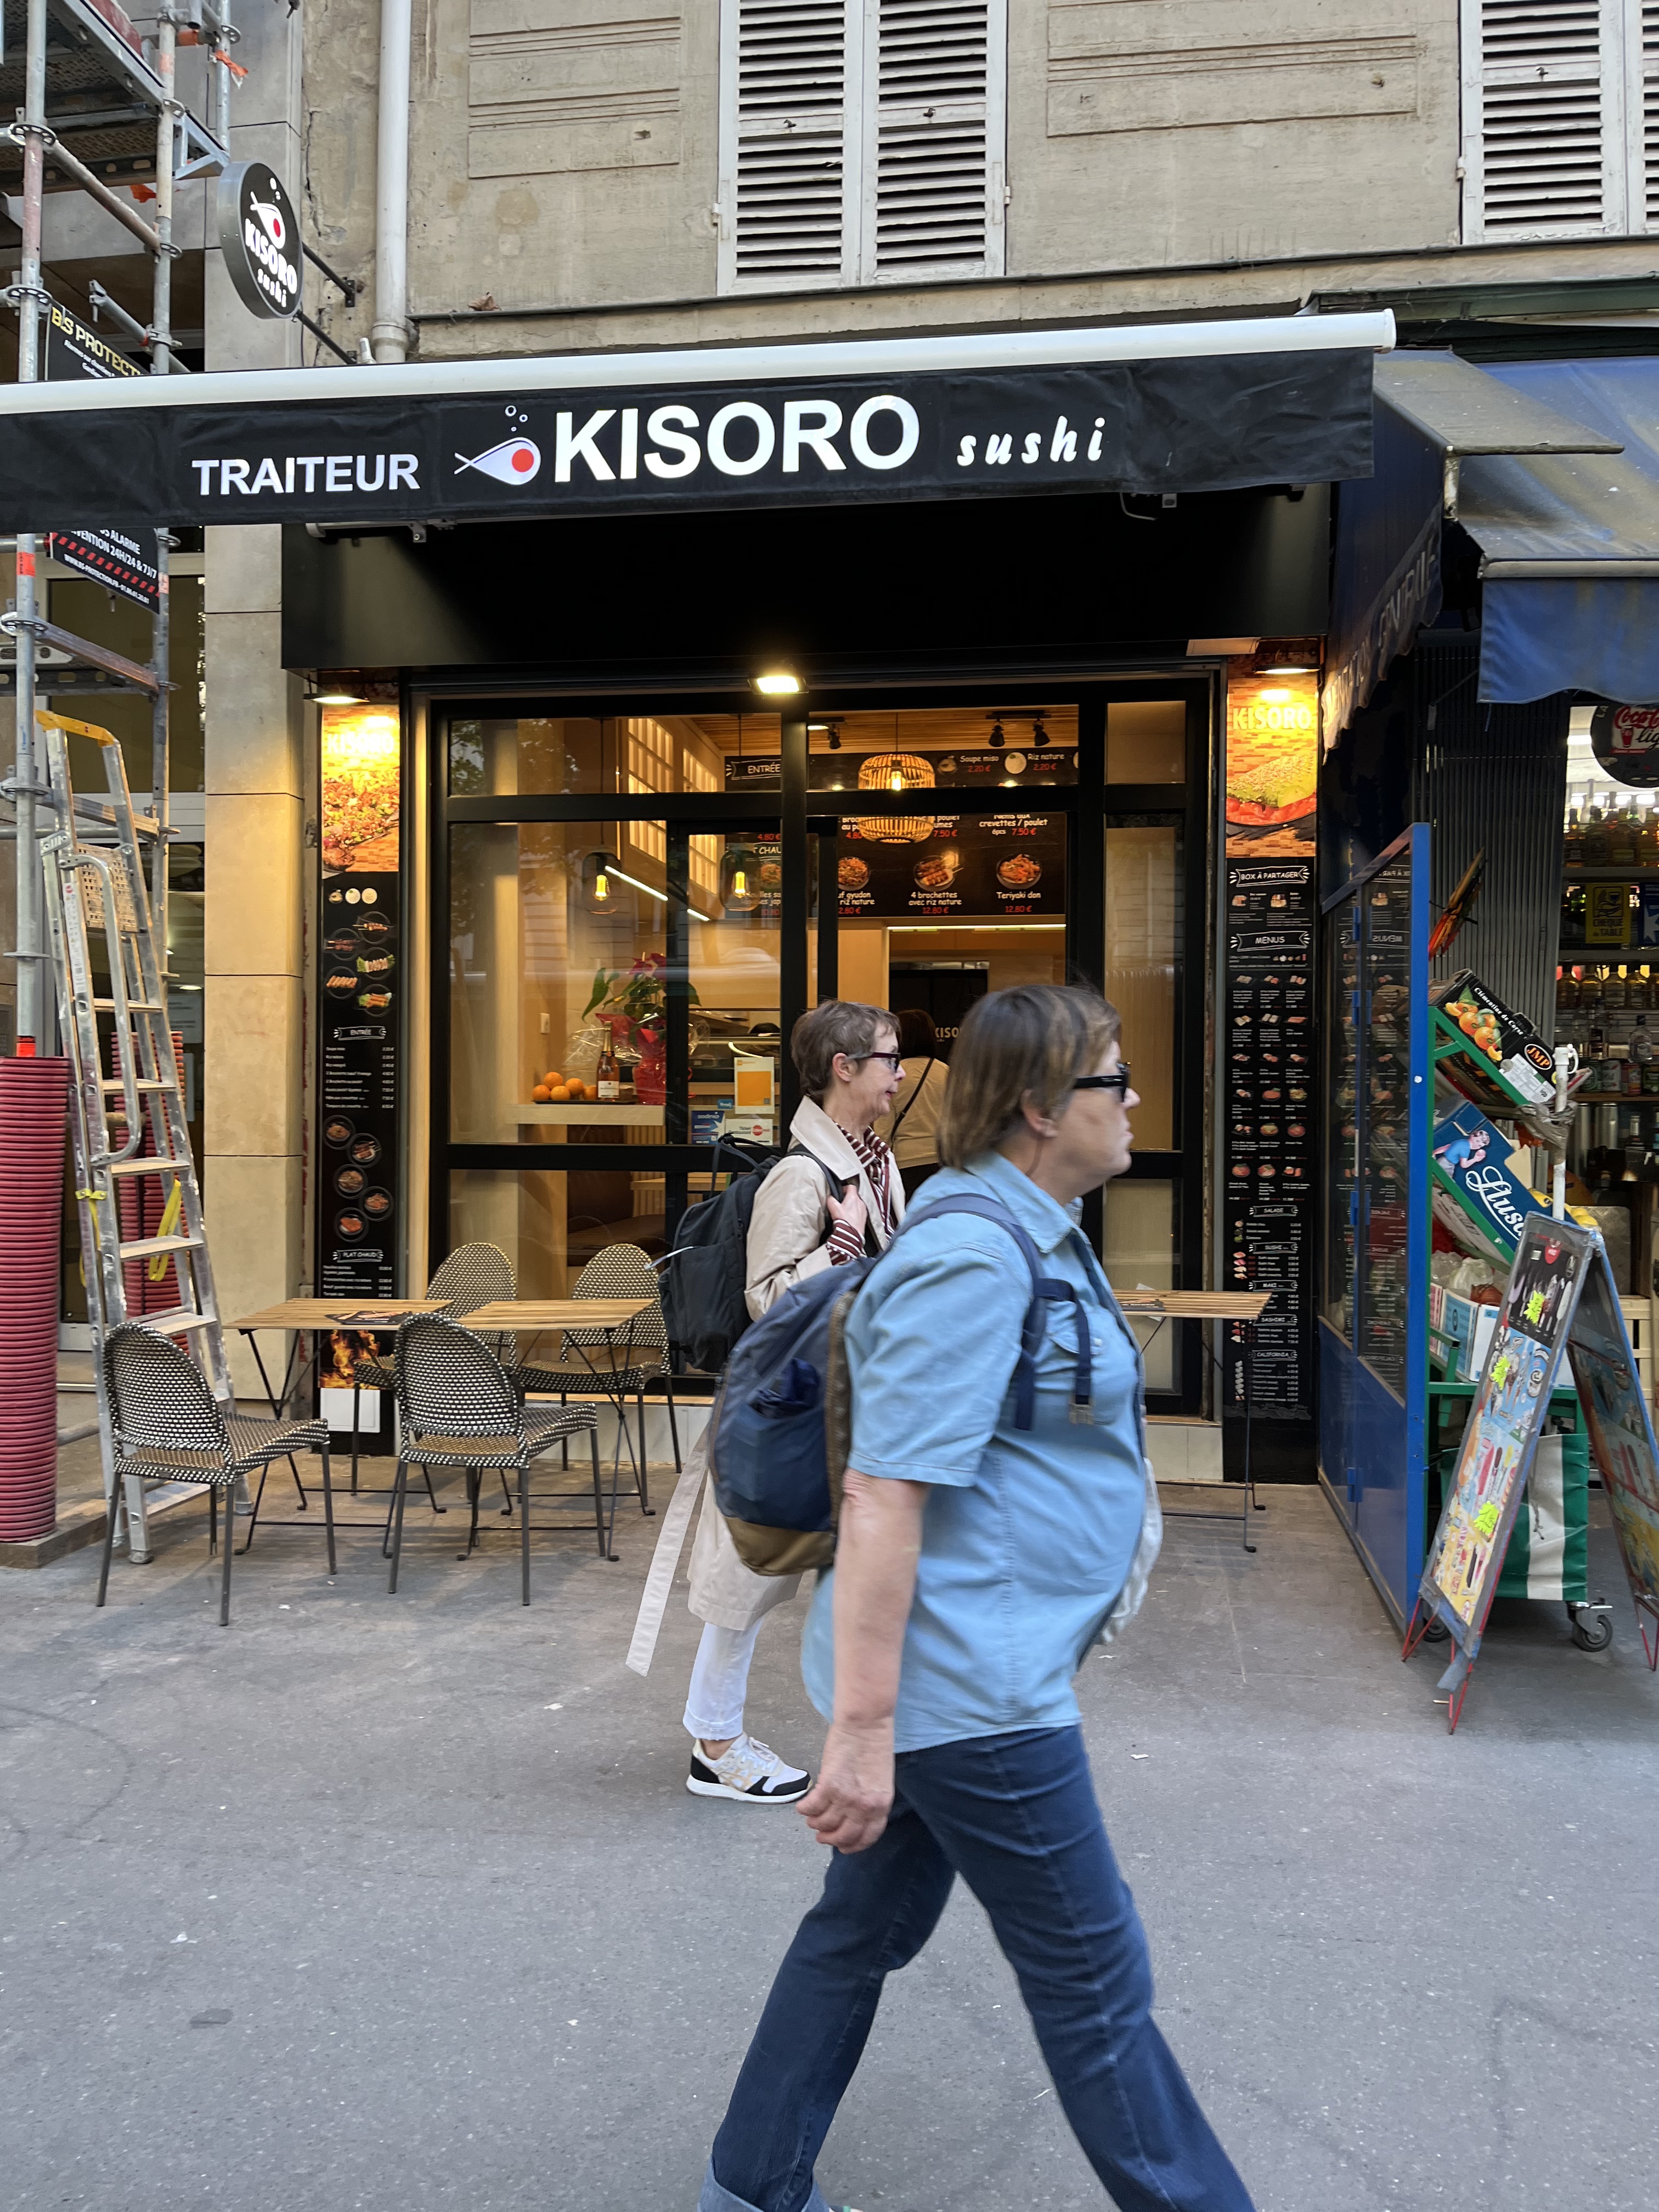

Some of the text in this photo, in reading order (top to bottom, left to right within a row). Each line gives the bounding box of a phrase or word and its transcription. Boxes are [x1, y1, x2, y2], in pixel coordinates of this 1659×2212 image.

[245, 218, 297, 294] KISORO
[257, 268, 287, 307] sushi
[554, 394, 921, 483] KISORO
[957, 416, 1105, 467] sushi
[191, 454, 420, 495] TRAITEUR
[110, 530, 140, 555] ALARME
[110, 545, 136, 568] 24H/24
[1233, 707, 1312, 730] KISORO
[960, 755, 981, 764] Soupe
[1024, 818, 1048, 827] poulet
[996, 891, 1026, 900] Teriyaki
[1255, 936, 1285, 944] MENUS
[1526, 1047, 1550, 1066] JMP
